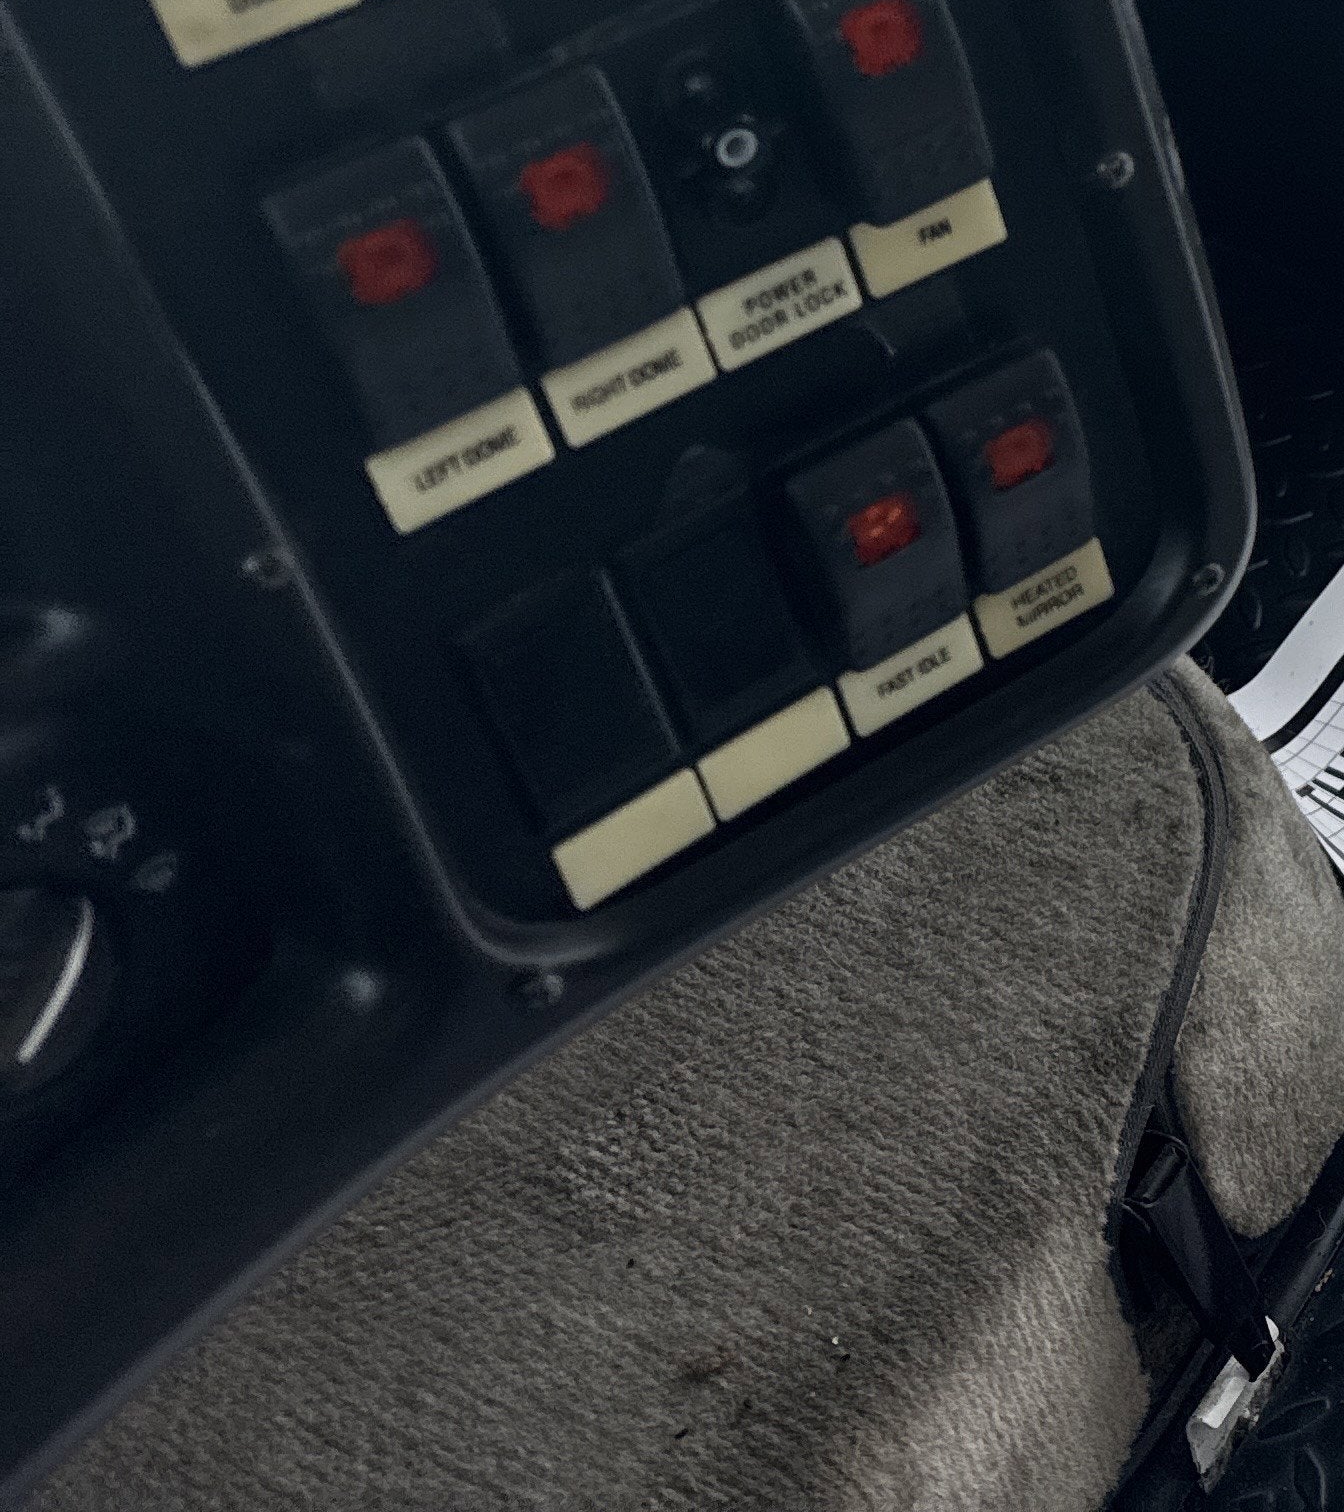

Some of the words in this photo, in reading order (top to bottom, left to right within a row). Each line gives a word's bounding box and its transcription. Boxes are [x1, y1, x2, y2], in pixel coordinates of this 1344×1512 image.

[918, 217, 953, 246] FAN
[728, 308, 788, 350] DOOR
[793, 280, 847, 318] LOCK
[743, 267, 817, 314] POWER
[570, 373, 627, 416] RIGHT
[627, 348, 683, 387] DOME
[414, 454, 462, 494] LEFT
[461, 425, 521, 469] DOME
[1011, 566, 1078, 610] HEATED
[1016, 584, 1086, 627] MIRROR
[877, 668, 916, 699] FAST
[916, 646, 951, 675] IDLE
